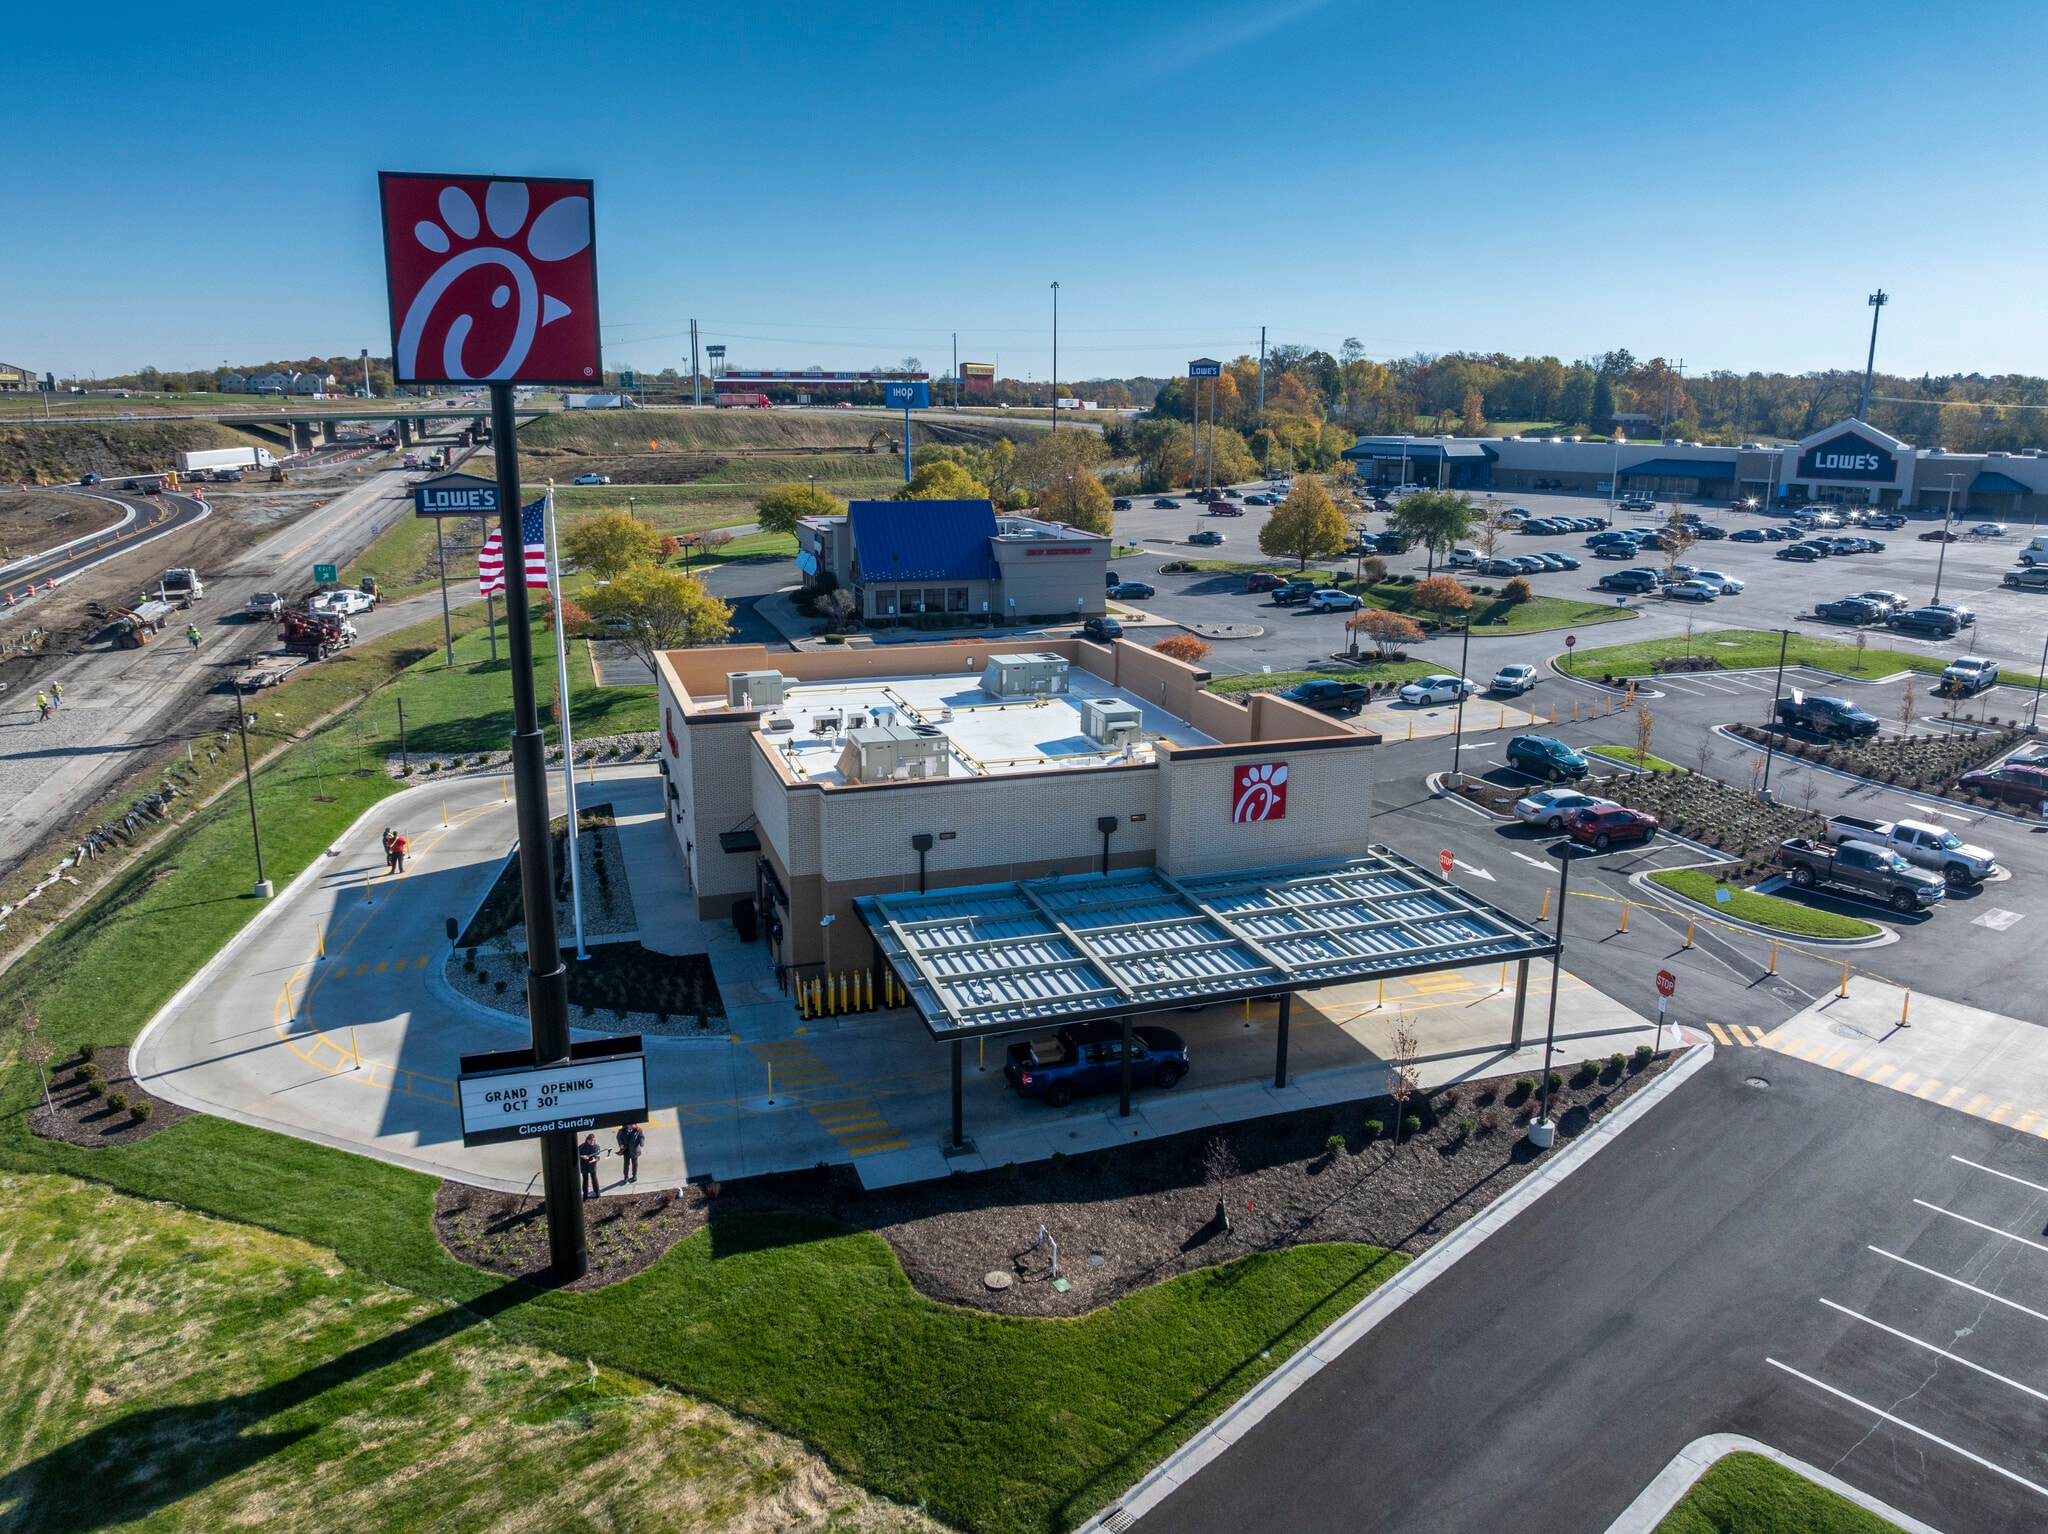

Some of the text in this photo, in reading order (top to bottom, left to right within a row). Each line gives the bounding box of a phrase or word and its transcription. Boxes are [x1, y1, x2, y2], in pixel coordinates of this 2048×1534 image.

[1191, 366, 1217, 375] LOWE'S
[893, 387, 914, 400] IHOP
[1815, 452, 1879, 470] LOWE'S
[423, 489, 495, 507] LOWE'S
[1441, 855, 1453, 866] STOP
[1657, 976, 1674, 990] STOP
[485, 1079, 594, 1102] GRAND OPENING
[503, 1096, 558, 1113] OCT 30!
[519, 1117, 595, 1135] Closed Sunday
